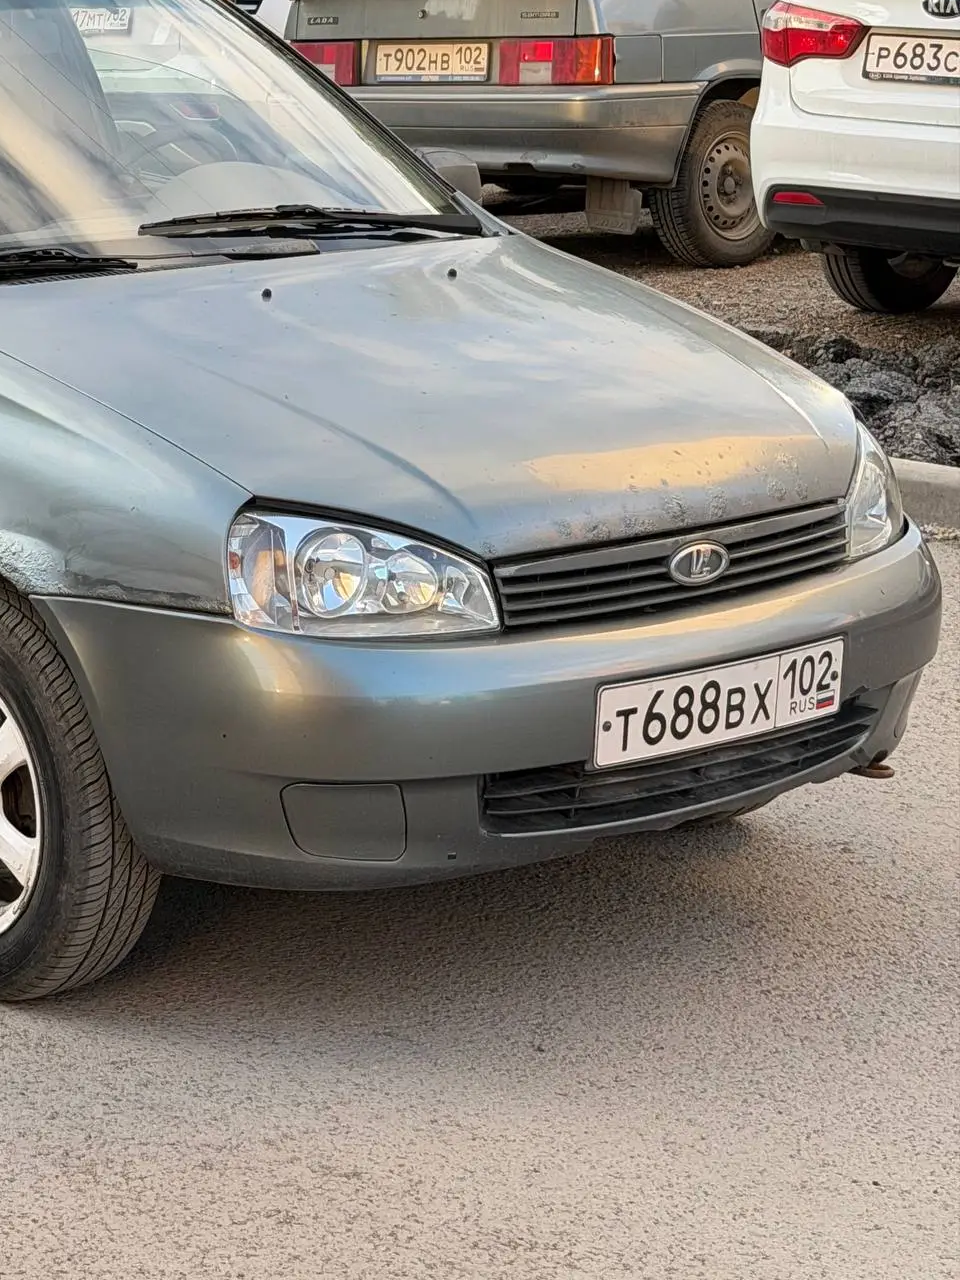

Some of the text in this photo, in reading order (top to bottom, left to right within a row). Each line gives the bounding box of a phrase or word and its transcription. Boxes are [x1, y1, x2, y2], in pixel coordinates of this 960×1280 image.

[383, 46, 482, 72] Т902НВ 102
[616, 650, 833, 752] Т688ВХ 102
[790, 696, 815, 716] RUS
